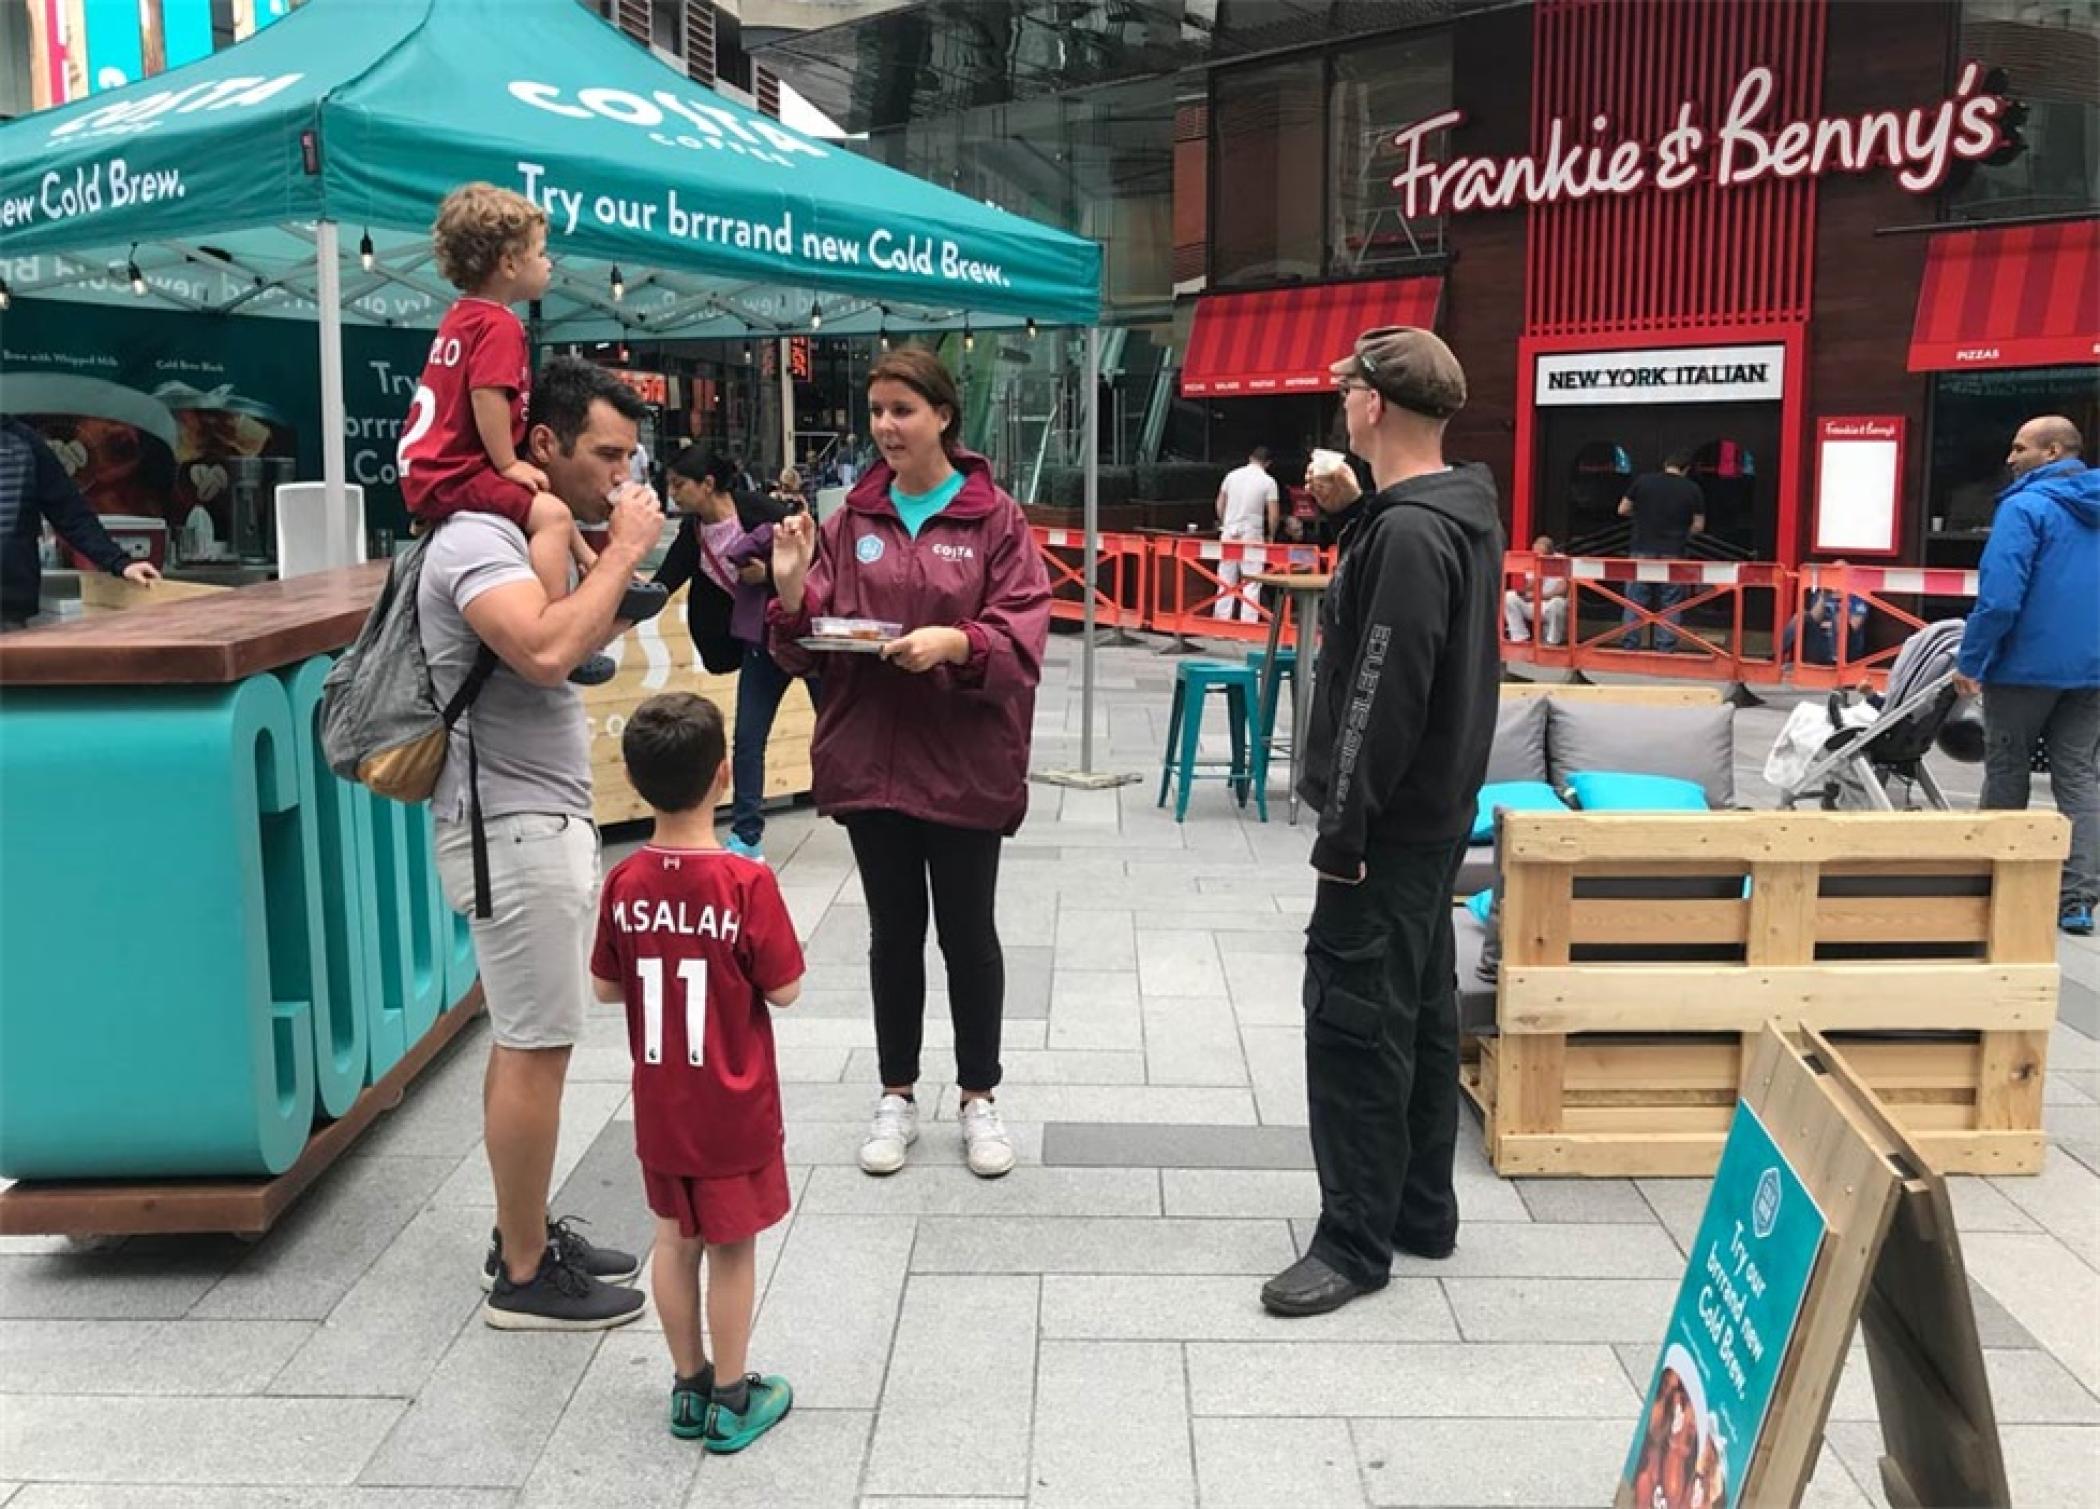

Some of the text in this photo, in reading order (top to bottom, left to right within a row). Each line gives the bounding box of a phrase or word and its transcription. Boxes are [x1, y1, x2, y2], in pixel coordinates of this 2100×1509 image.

[1393, 61, 1997, 219] Frankie & Benny's
[0, 158, 186, 228] ew Cold Brew.
[517, 161, 1011, 288] Try our brrrand new Cold Brew.
[1549, 362, 1768, 390] NEW YORK ITALIAN
[635, 956, 708, 1067] 11
[1698, 1284, 1727, 1344] Cold
